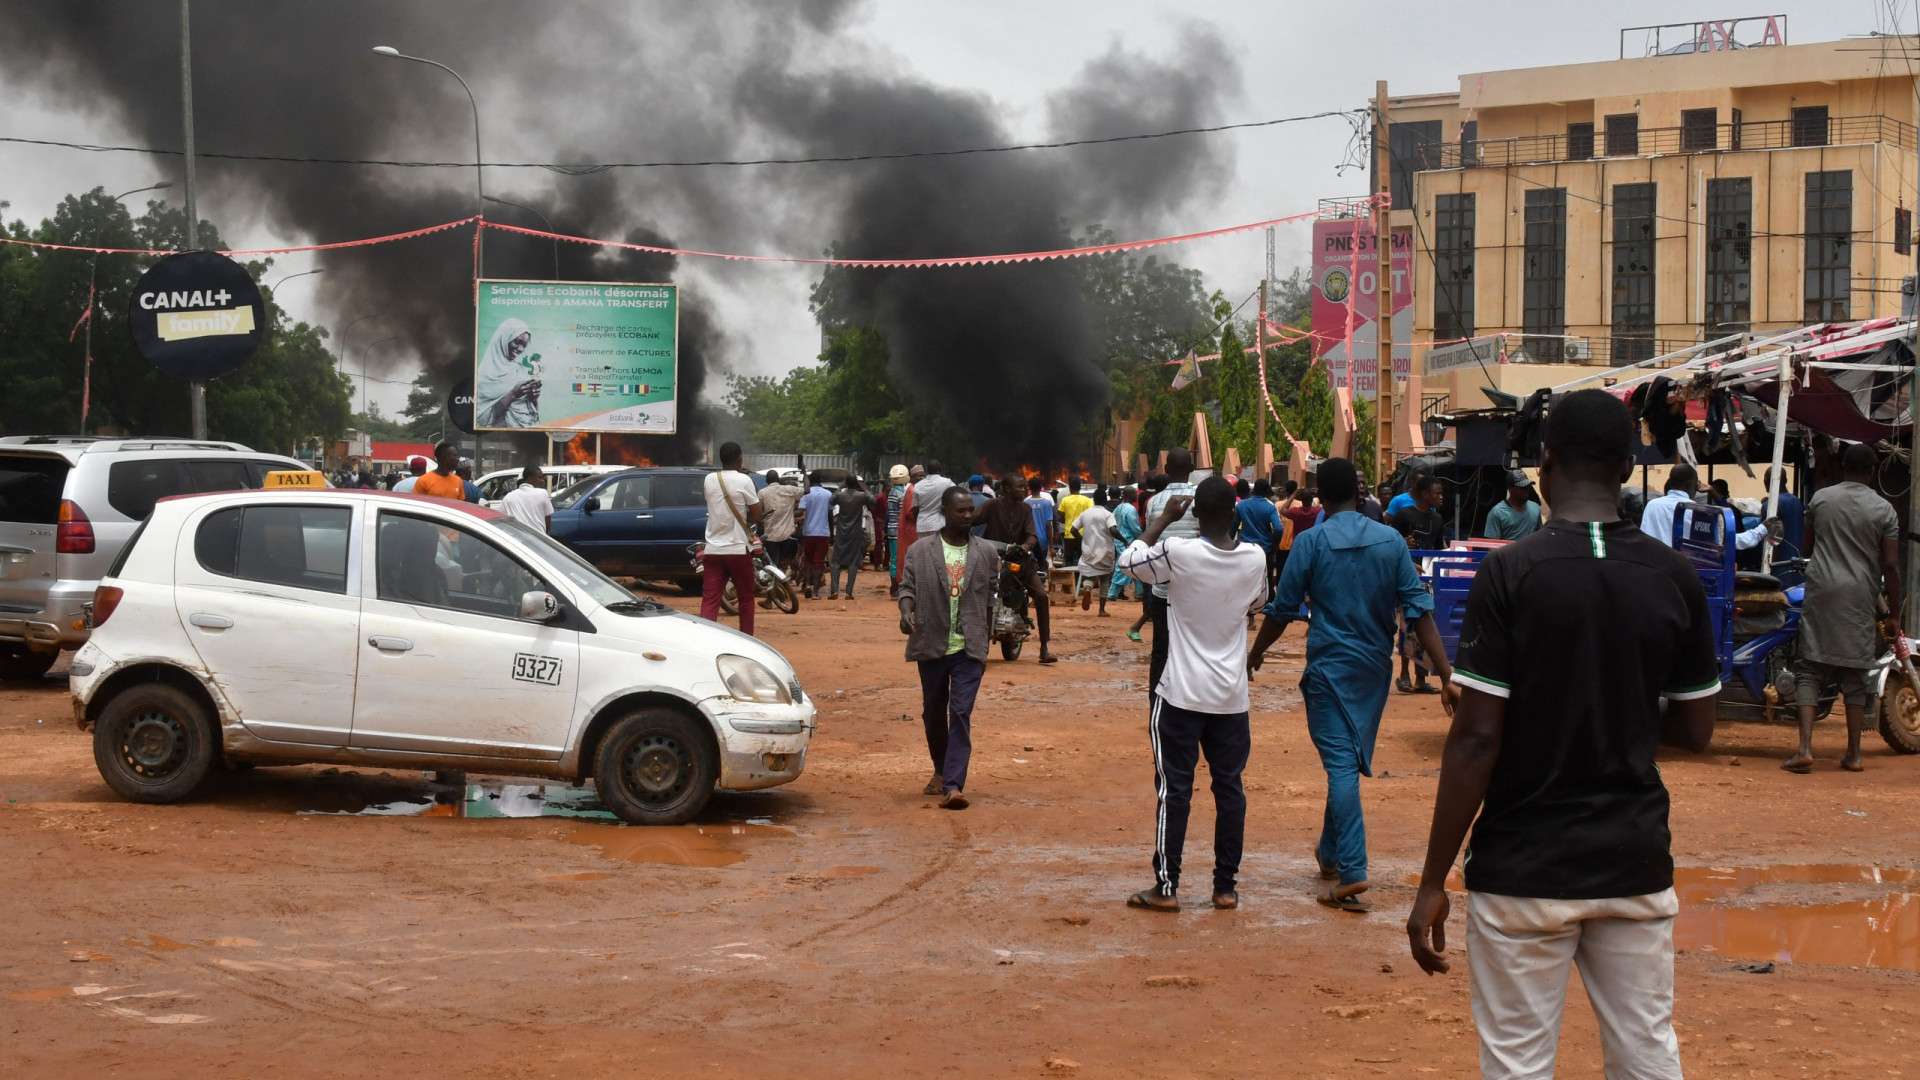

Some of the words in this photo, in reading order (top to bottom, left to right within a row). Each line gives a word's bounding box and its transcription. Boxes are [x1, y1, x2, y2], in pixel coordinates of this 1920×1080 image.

[491, 285, 544, 296] Services
[547, 286, 600, 297] Ecobank
[605, 287, 669, 299] désormais
[140, 289, 232, 310] CANAL+
[562, 298, 604, 307] AMANA
[607, 299, 669, 309] TRANSFERT
[169, 311, 241, 333] family
[576, 324, 615, 333] Recharge
[618, 332, 660, 340] ECOBANK
[627, 349, 671, 357] FACTURES
[631, 367, 663, 375] UEMOA
[276, 474, 311, 486] TAXI
[516, 657, 559, 681] 9327
